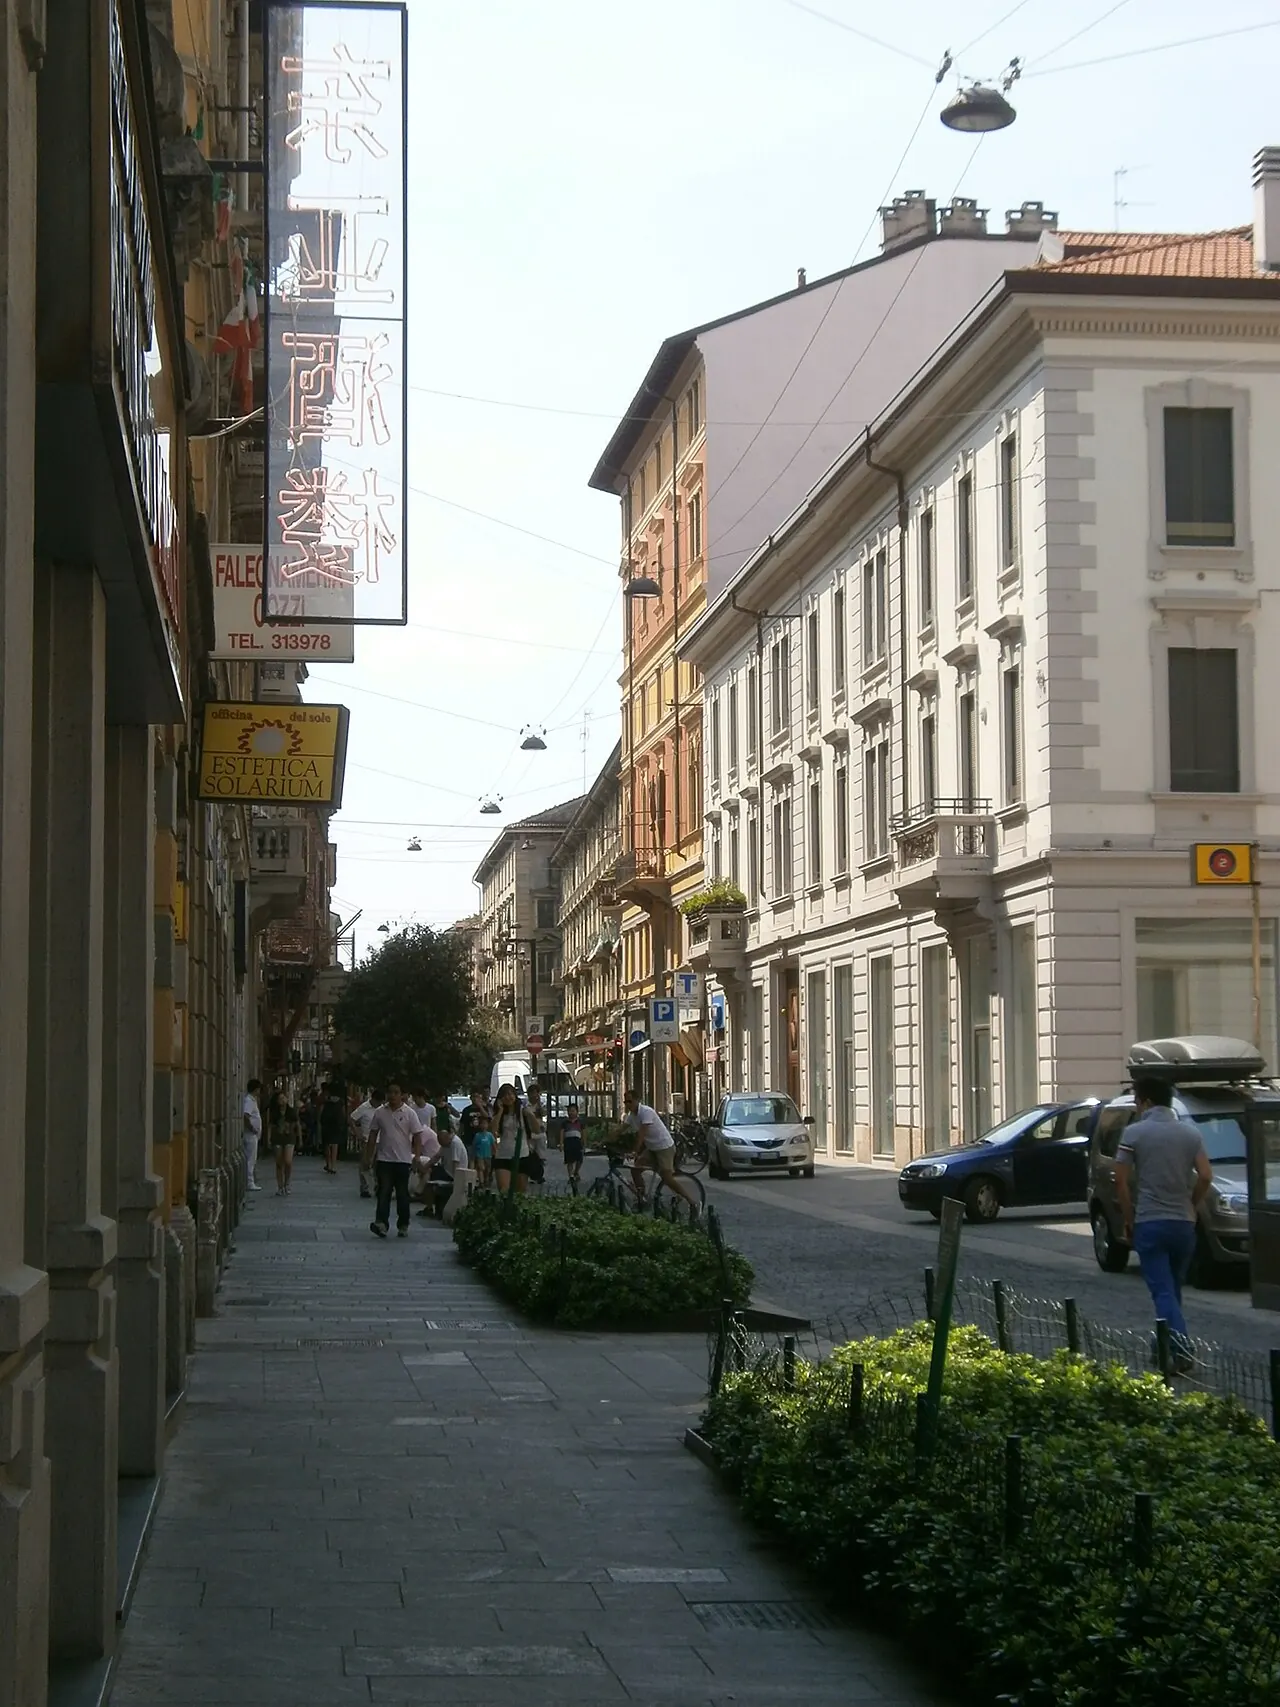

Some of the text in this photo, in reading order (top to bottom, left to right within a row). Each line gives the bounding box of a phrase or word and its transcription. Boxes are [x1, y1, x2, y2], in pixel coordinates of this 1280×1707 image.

[227, 633, 331, 650] TEL. 313978
[211, 708, 331, 723] officina del sole
[211, 756, 320, 778] ESTETICA
[203, 775, 323, 798] SOLARIUM
[679, 975, 697, 994] T
[658, 1003, 671, 1020] P
